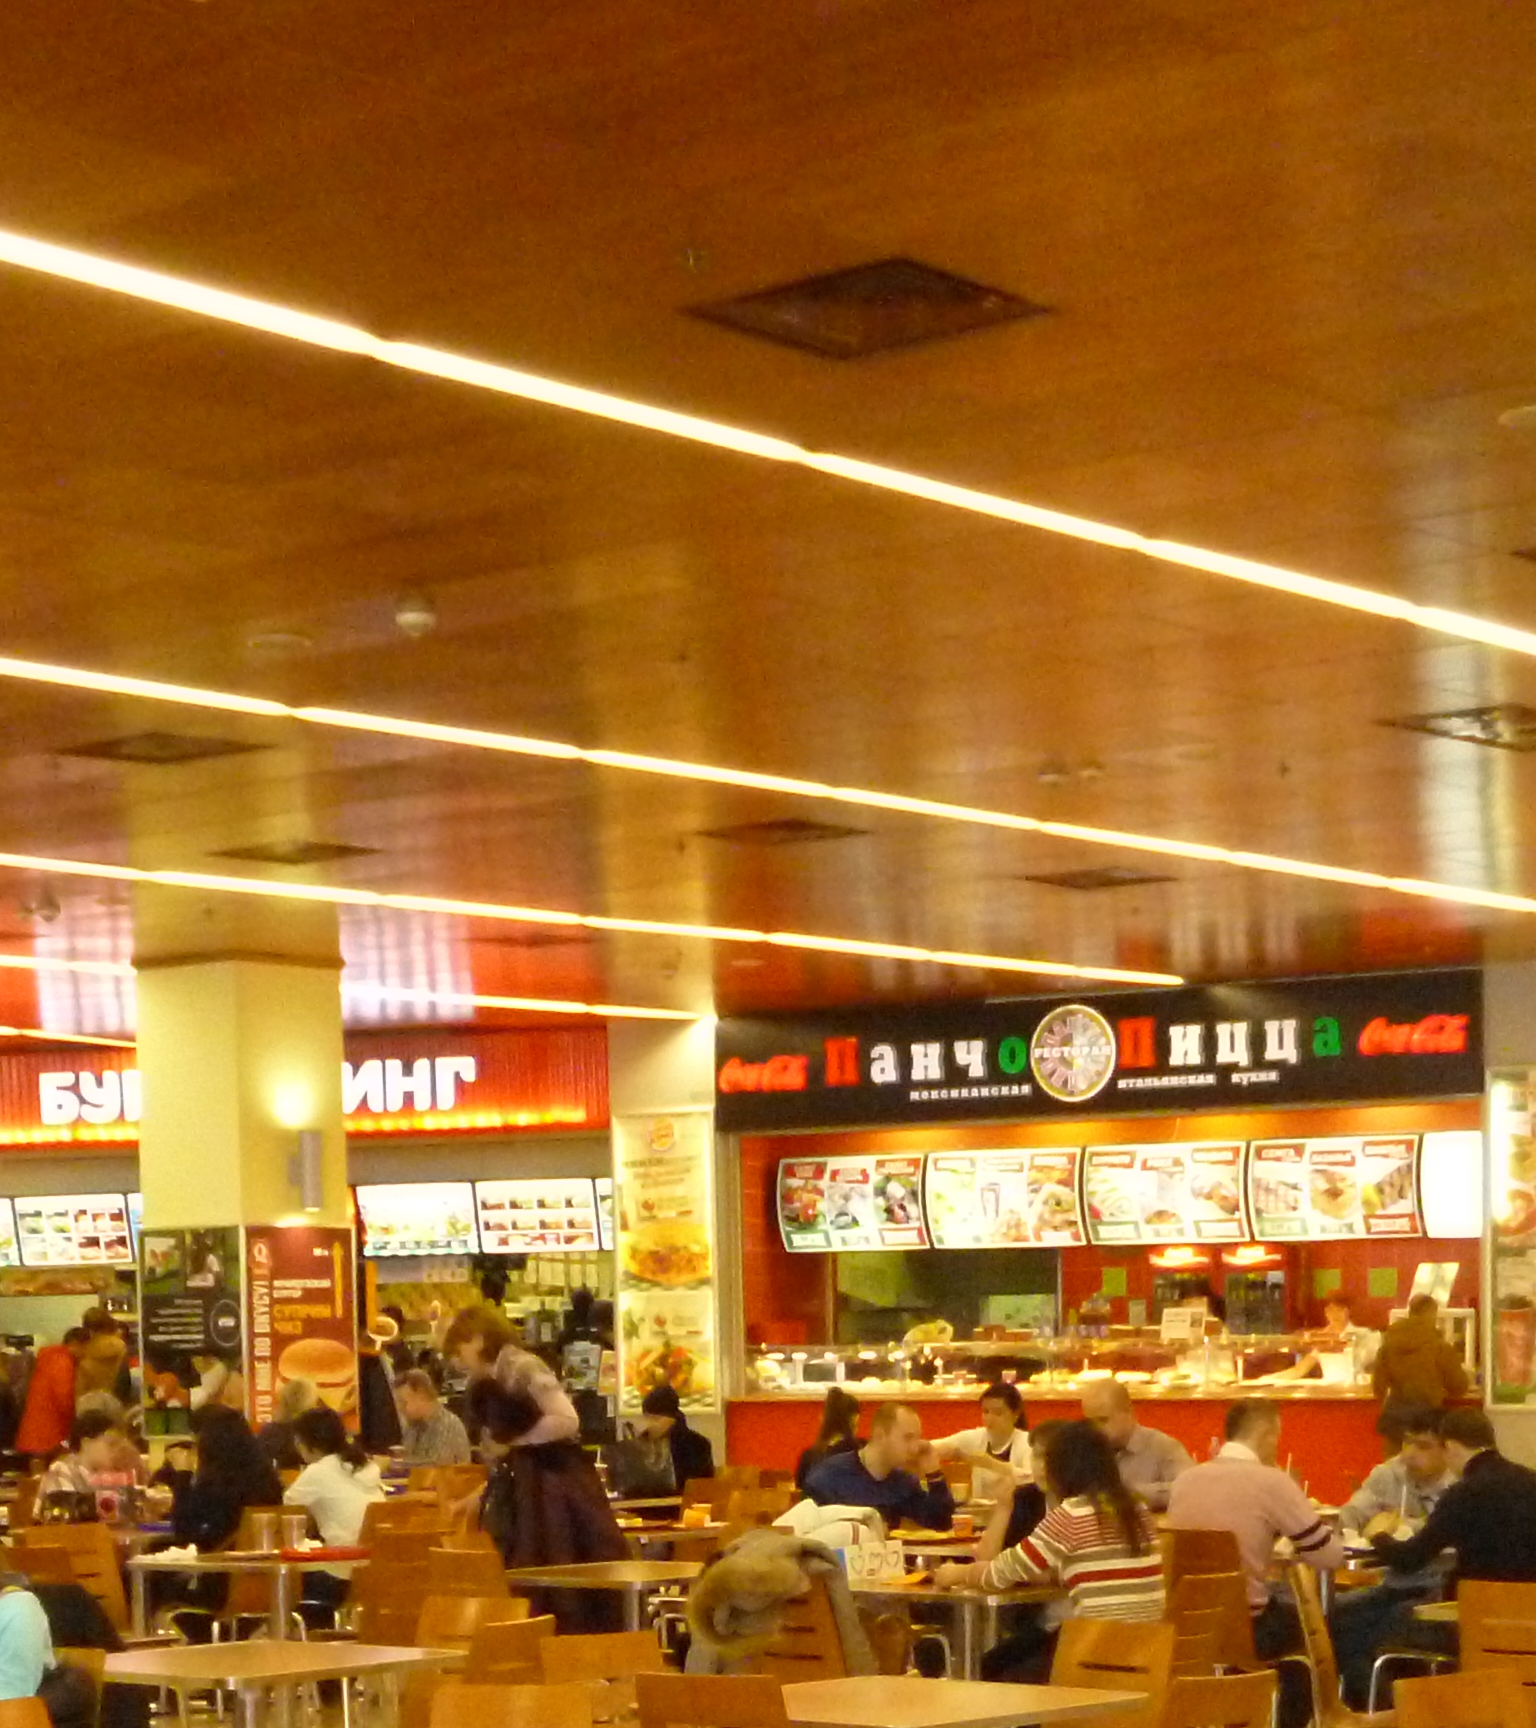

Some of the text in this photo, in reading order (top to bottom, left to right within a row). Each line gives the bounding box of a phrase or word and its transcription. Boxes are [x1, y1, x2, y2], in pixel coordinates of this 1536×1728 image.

[824, 1014, 1343, 1087] Панчо Пицца
[1033, 1044, 1113, 1060] РЕСТОРАН
[341, 1055, 476, 1115] ИНГ
[909, 1069, 1280, 1102] мексиканская итальянская кухня
[253, 1336, 272, 1357] ПО
